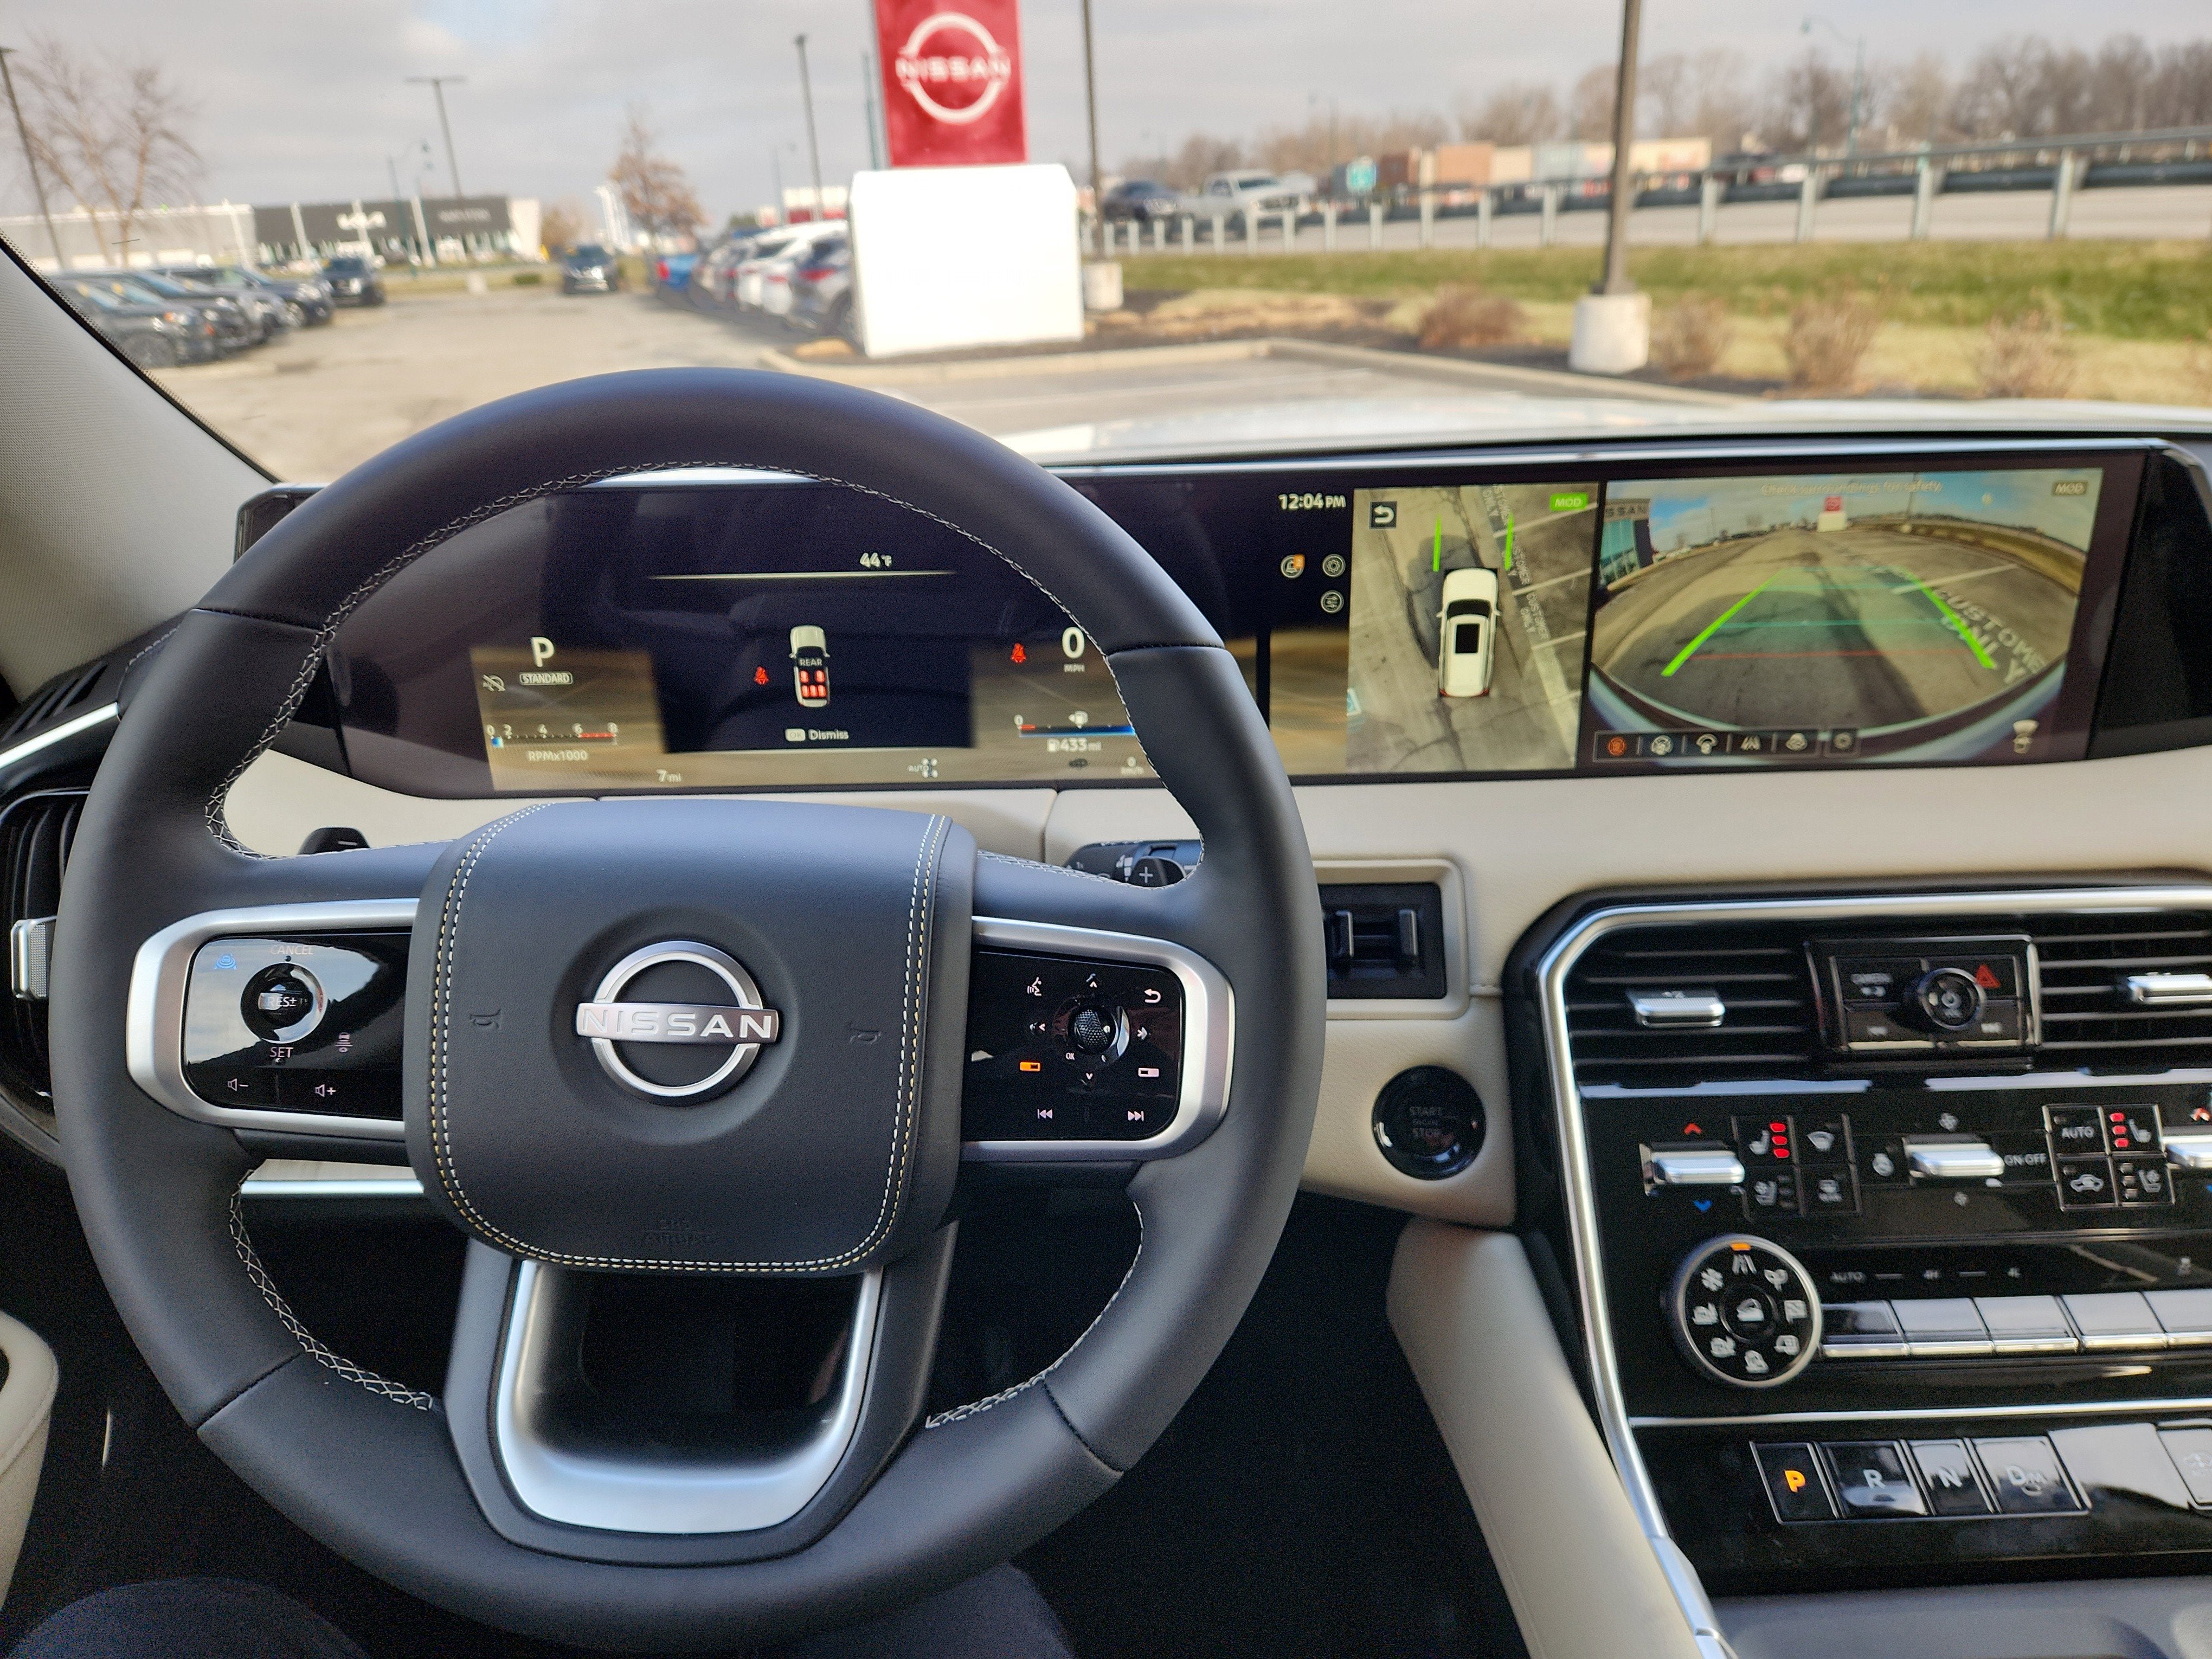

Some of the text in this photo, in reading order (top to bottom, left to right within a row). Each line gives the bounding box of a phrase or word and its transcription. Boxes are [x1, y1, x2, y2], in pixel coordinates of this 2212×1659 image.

[896, 56, 1011, 82] NISSAN
[1278, 493, 1347, 510] 12:04 PM
[1554, 497, 1583, 508] MOD
[1062, 627, 1085, 659] 0
[531, 636, 555, 667] P
[799, 657, 822, 666] REAR
[1063, 664, 1085, 673] MPH
[523, 672, 570, 684] STANDARD
[537, 723, 548, 734] 4
[573, 723, 583, 734] 6
[608, 722, 618, 734] 8
[808, 729, 849, 741] Dismiss
[1059, 737, 1088, 751] 433
[526, 750, 589, 762] RPMx1000
[270, 944, 314, 956] CANCEL
[582, 1009, 771, 1039] NISSAN
[269, 1046, 294, 1058] SET
[1065, 1052, 1076, 1061] OK
[2061, 1126, 2095, 1139] AUTO
[1830, 1271, 1867, 1283] AUTO
[1784, 1470, 1806, 1493] P
[1862, 1469, 1886, 1490] R
[1938, 1466, 1963, 1488] N
